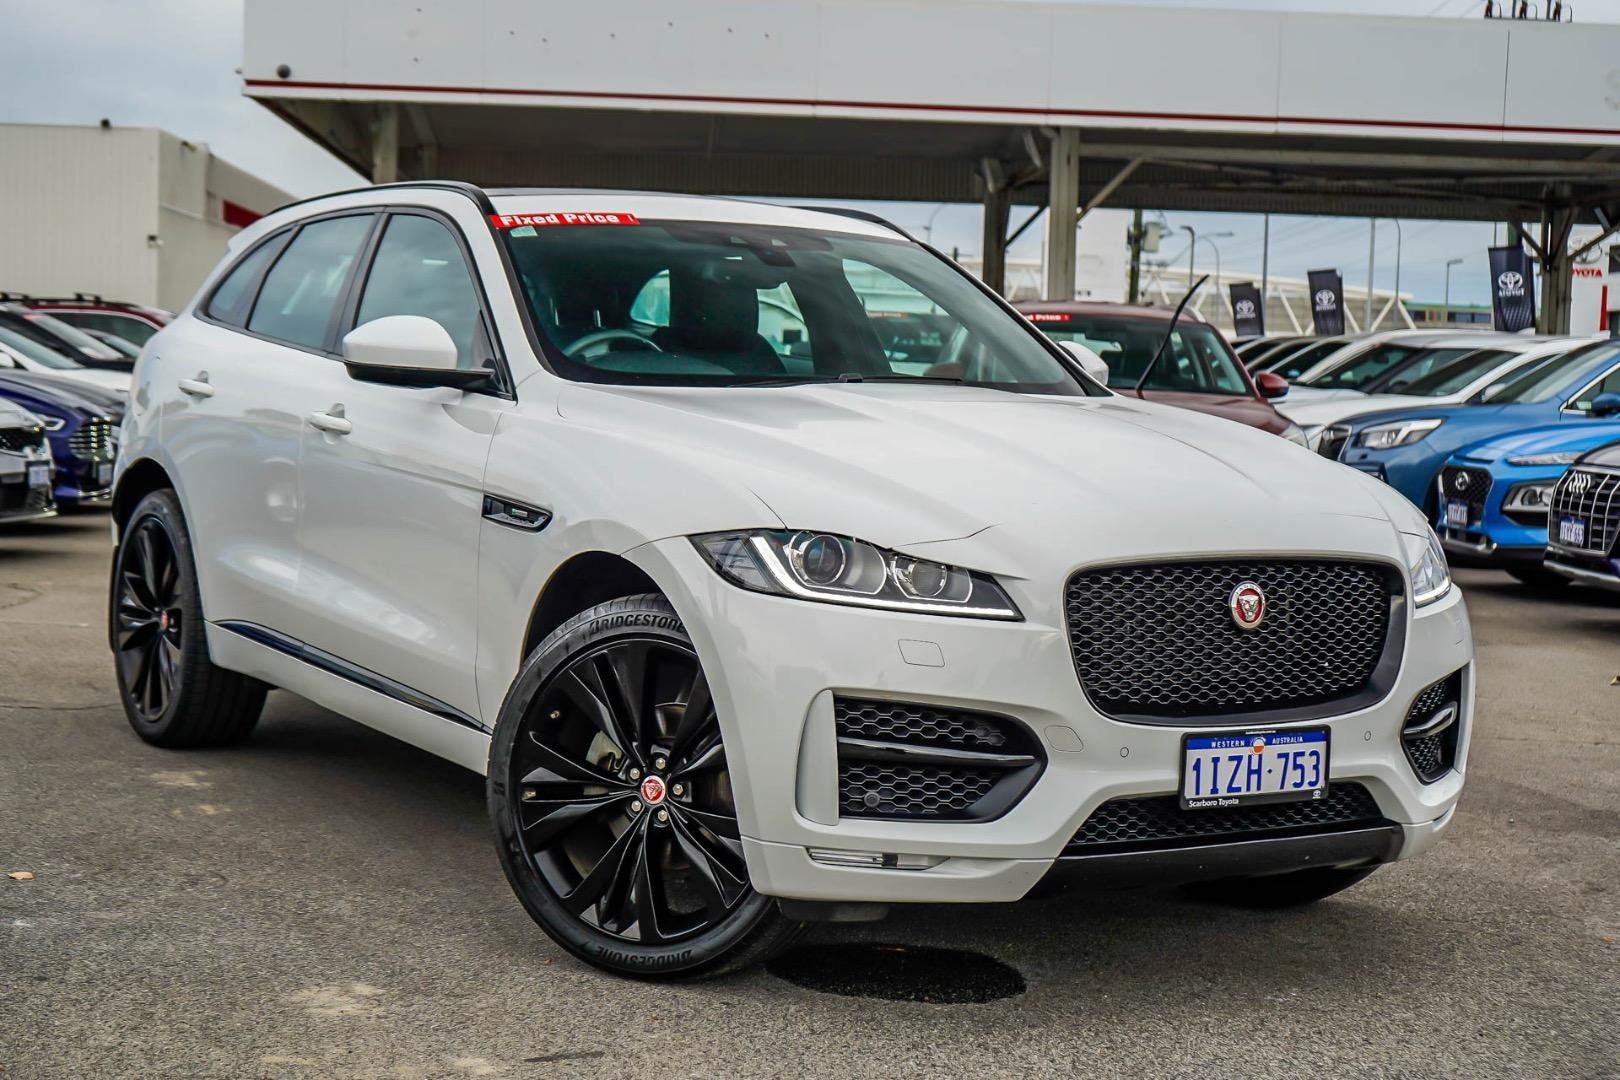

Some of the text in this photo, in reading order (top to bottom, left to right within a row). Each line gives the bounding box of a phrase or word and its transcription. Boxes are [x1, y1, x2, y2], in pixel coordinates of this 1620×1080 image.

[500, 213, 620, 226] Fixed Price
[1570, 267, 1602, 277] YOTA
[1211, 736, 1303, 748] WESTERN AUSTRALIA
[1188, 798, 1239, 808] Scarboro Toyota
